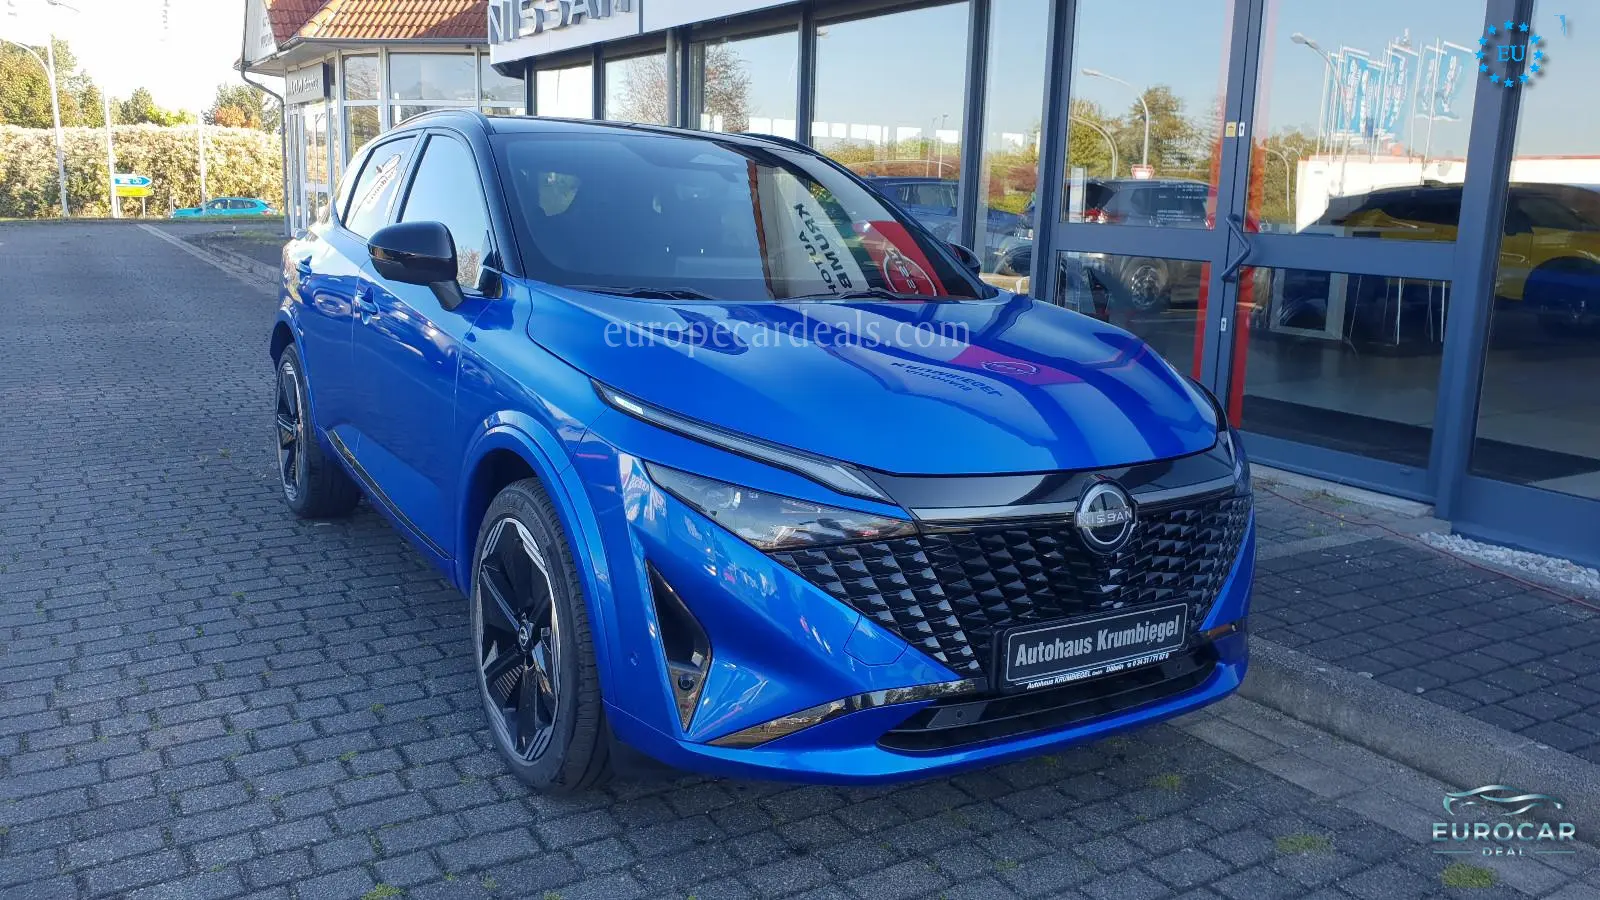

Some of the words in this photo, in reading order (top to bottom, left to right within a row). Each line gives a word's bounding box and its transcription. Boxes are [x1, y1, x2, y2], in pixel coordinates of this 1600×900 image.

[1078, 510, 1132, 525] NISSAN
[1015, 636, 1093, 667] Autohaus
[1096, 615, 1180, 652] Krumbiegel
[1026, 679, 1054, 690] Autohaus
